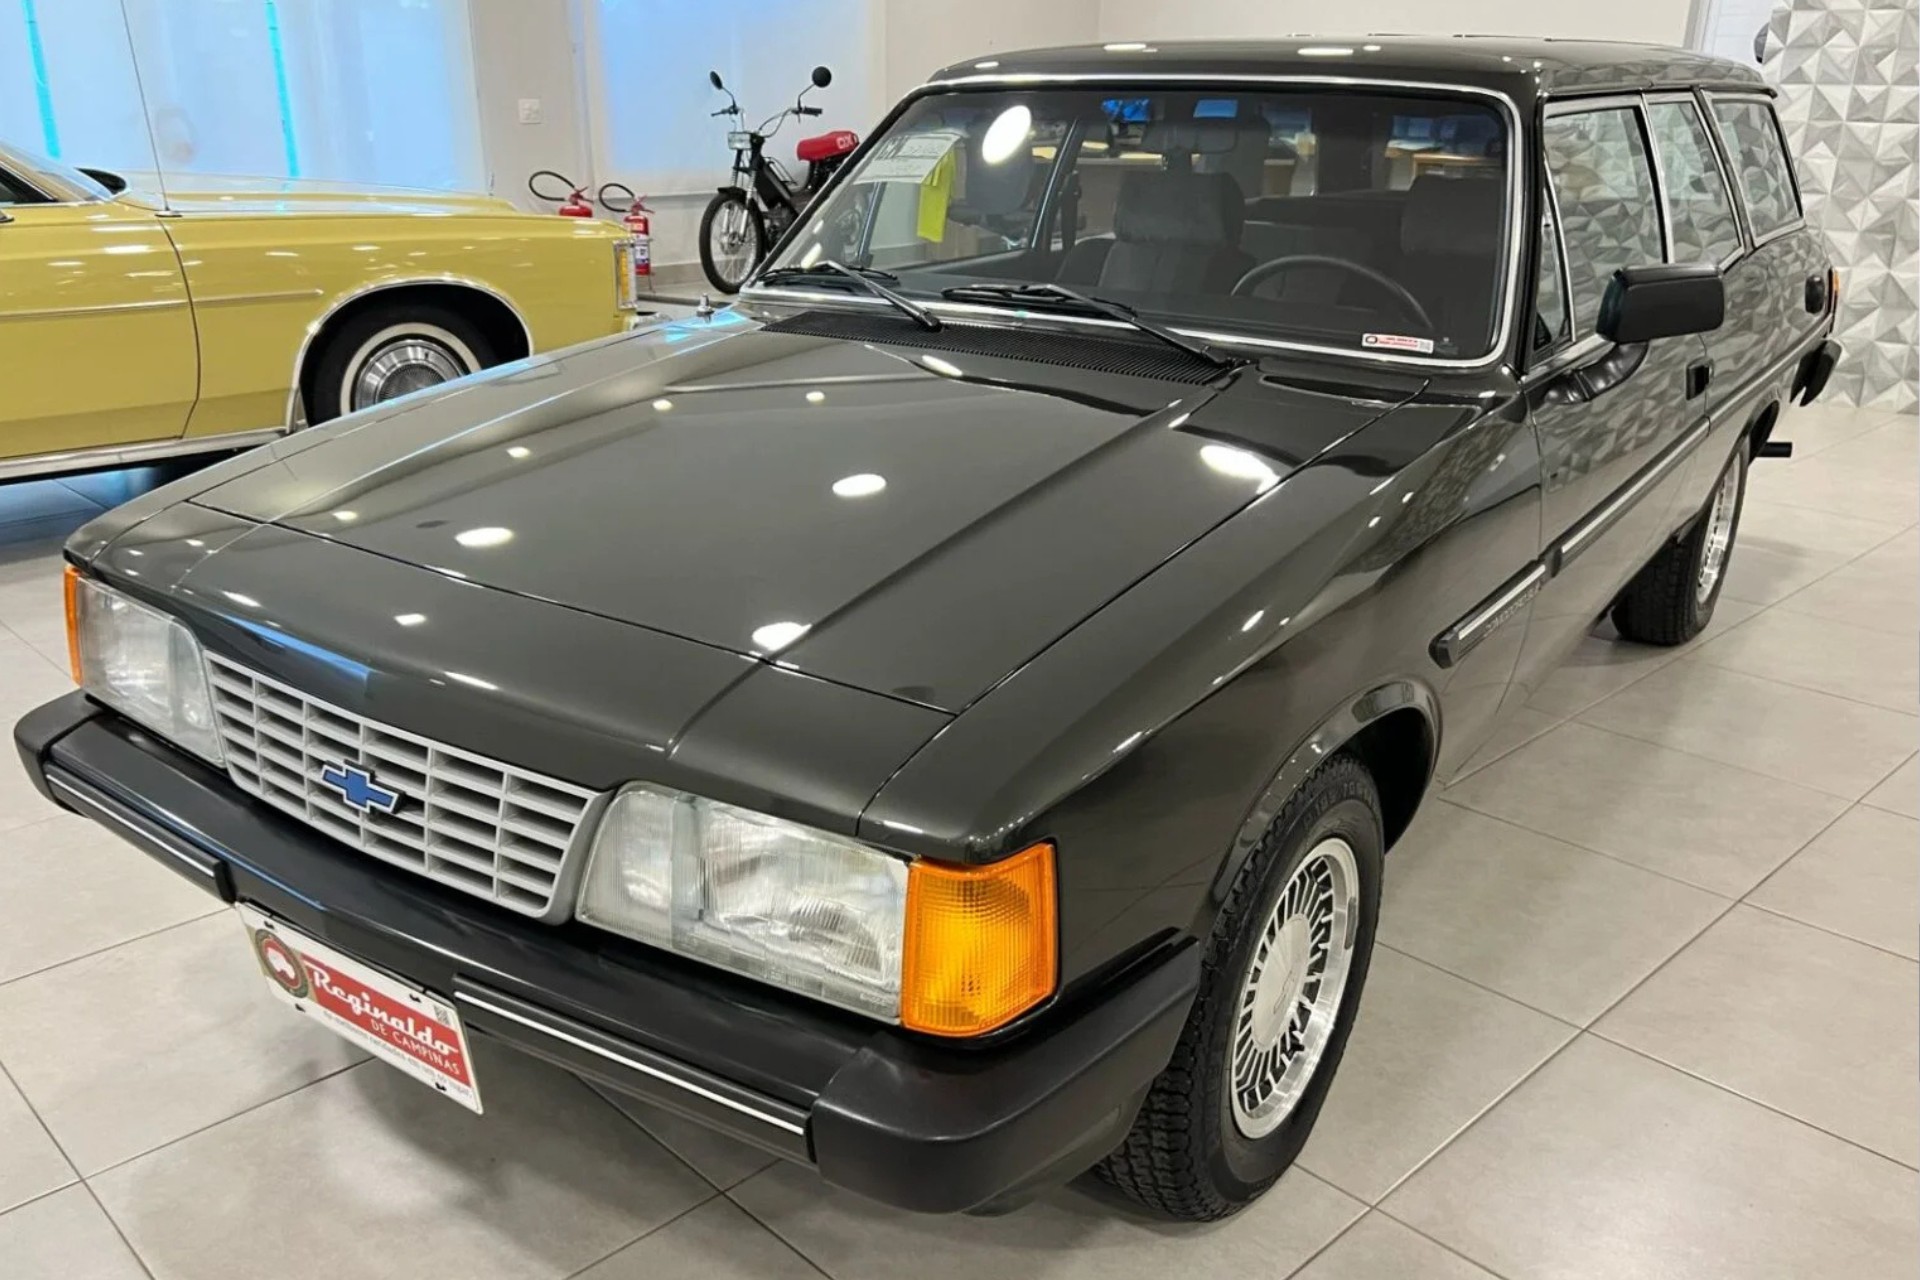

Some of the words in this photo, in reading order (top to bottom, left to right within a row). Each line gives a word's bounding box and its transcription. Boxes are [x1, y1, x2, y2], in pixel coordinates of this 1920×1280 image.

[303, 960, 459, 1055] Reginaldo
[370, 1018, 388, 1037] DE
[392, 1031, 460, 1076] CAMPINAS
